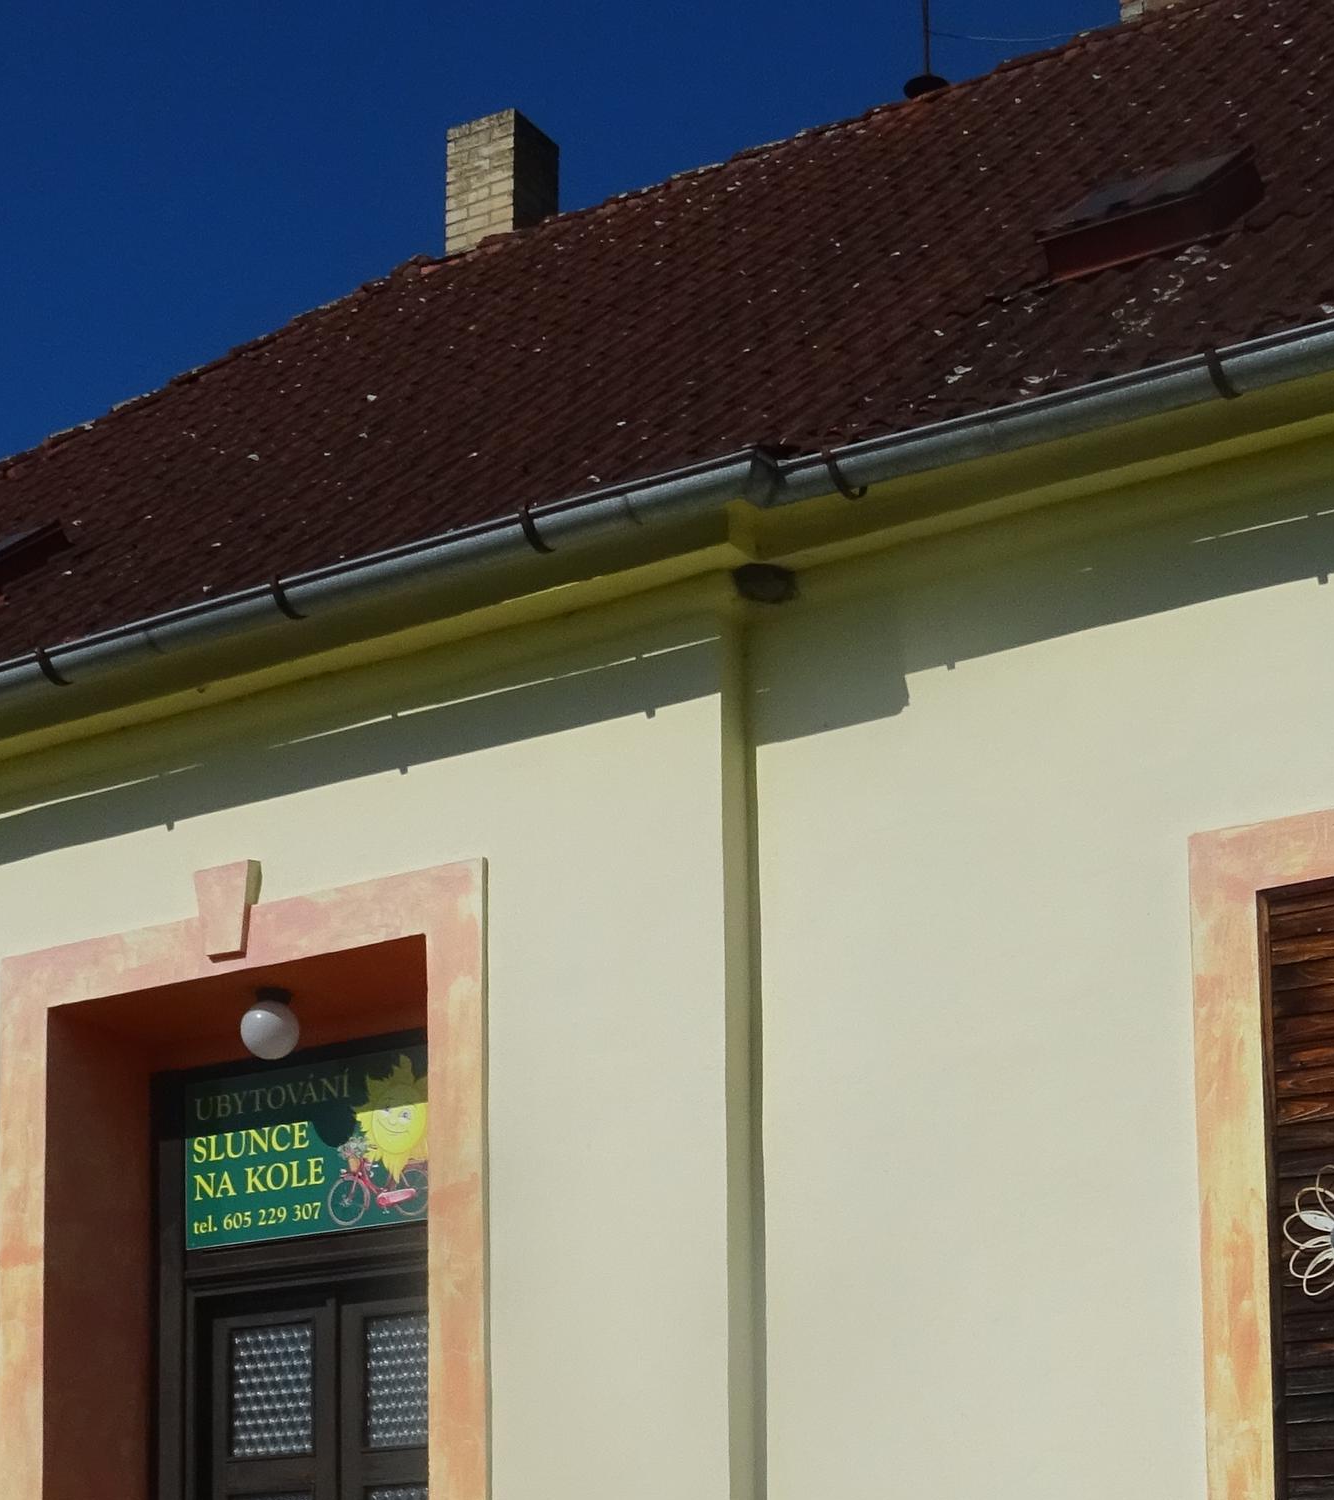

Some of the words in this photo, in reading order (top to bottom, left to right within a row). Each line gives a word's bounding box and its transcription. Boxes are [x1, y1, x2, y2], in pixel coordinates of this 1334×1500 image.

[195, 1068, 349, 1121] UBYTOVÁNÍ
[193, 1121, 310, 1163] SLUNCE
[194, 1171, 236, 1201] NA
[245, 1157, 325, 1194] KOLE
[194, 1214, 217, 1235] tel.
[223, 1213, 251, 1230] 605
[258, 1207, 287, 1225] 229
[293, 1202, 321, 1221] 307
